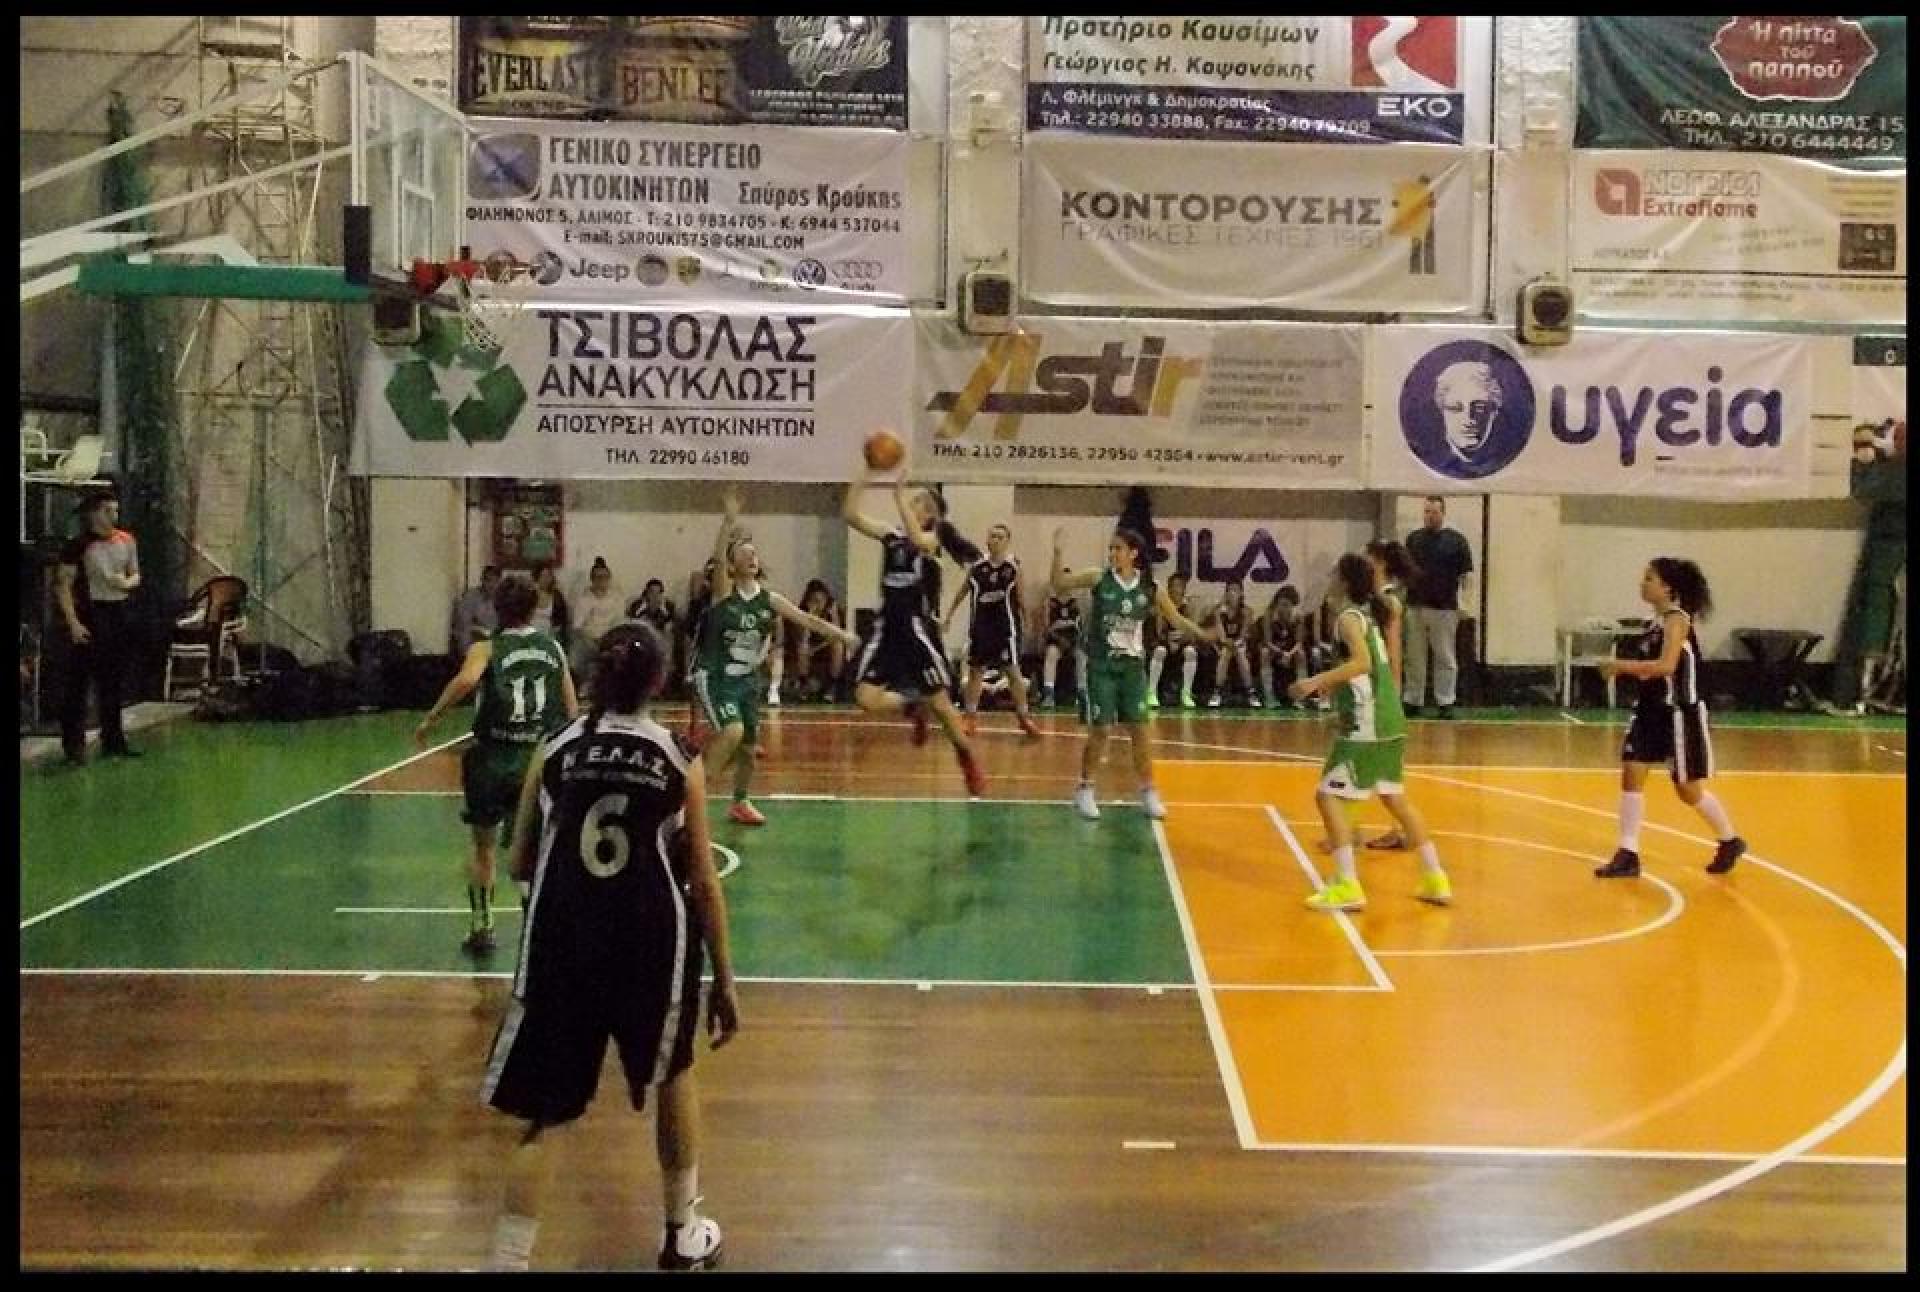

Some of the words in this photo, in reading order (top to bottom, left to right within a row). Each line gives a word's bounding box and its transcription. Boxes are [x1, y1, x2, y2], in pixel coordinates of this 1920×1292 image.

[1181, 18, 1320, 49] Καυσίμων
[1042, 52, 1147, 75] Γεώργιος
[1377, 97, 1451, 118] EKO
[548, 137, 630, 165] ΓΕΝΙΚΟ
[638, 140, 761, 170] ΣΥΝΕΡΓΕΙΟ
[548, 173, 710, 205] ΑΥΤΟΚΙΝΗΤΩΝ
[738, 181, 811, 211] Σπύρος
[816, 183, 902, 213] Κρούκης
[1060, 190, 1382, 225] ΚΟΝΤΟΡΟΥΣΗΣ
[1643, 198, 1758, 219] Extraflame
[568, 257, 631, 283] Jeep
[537, 310, 817, 363] ΤΣΙΒΟΛΑΣ
[537, 364, 816, 402] ΑΝΑΚΥΚΛΩΣΗ
[537, 415, 653, 435] ΑΠΟΣΥΡΣΗ
[660, 416, 815, 437] ΑΥΤΟΚΙΝΗΤΩΝ
[1549, 366, 1783, 467] υγεία
[509, 675, 546, 723] 11
[579, 793, 630, 879] 6
